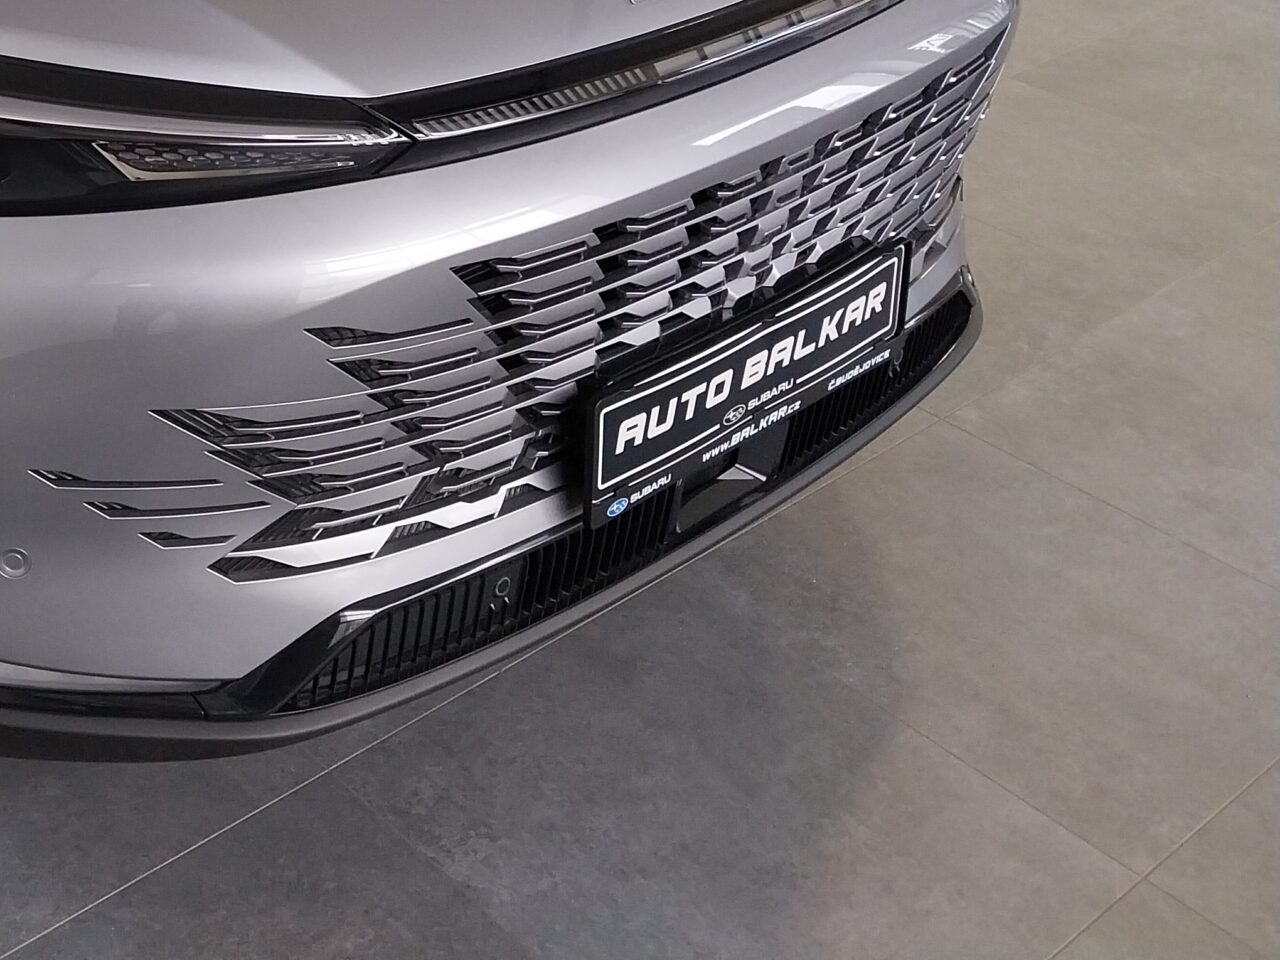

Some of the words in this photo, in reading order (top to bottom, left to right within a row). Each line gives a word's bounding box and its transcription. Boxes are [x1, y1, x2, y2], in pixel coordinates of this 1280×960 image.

[615, 369, 734, 455] AUTO
[741, 281, 888, 390] BALKAR
[747, 378, 794, 410] SUBARU
[702, 400, 801, 462] www.BALKAR.cz
[630, 473, 672, 503] SUBARU
